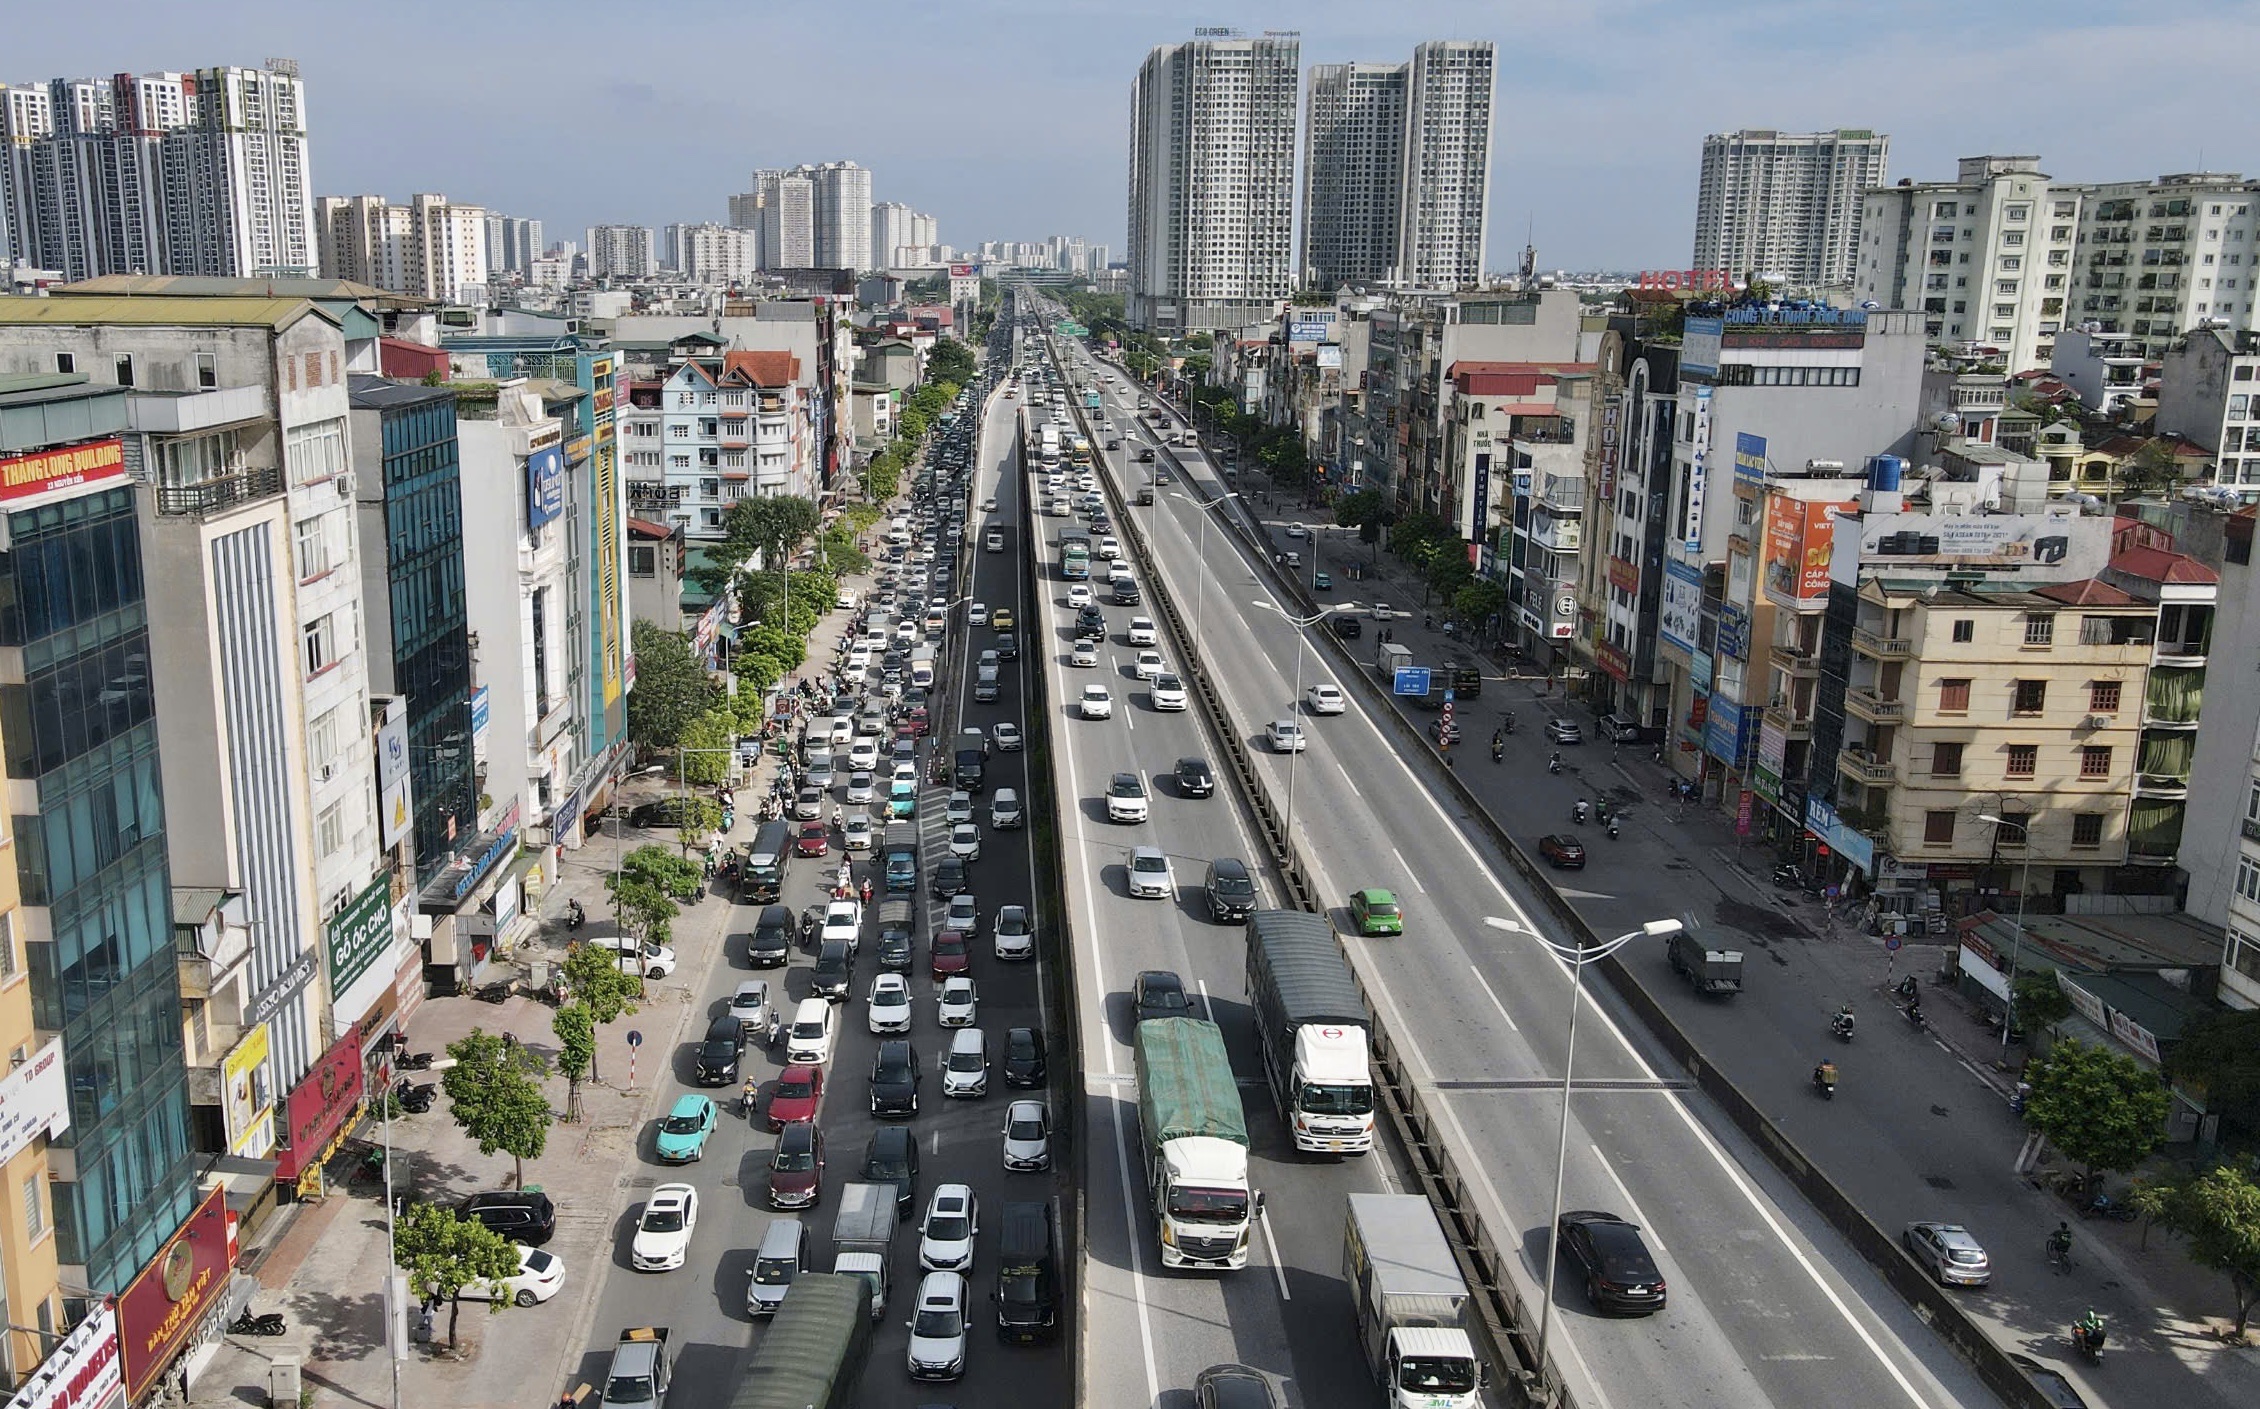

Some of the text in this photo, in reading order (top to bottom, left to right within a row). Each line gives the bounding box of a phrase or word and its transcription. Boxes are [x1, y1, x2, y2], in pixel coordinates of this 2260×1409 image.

[1208, 27, 1230, 37] GREEN
[1640, 269, 1738, 292] HOTEL
[42, 454, 74, 478] LONG
[73, 444, 122, 471] BUILDING
[1600, 408, 1618, 499] HOTEL
[1809, 800, 1829, 827] RÈM
[336, 899, 387, 967] GỖ ÓC CHÓ
[35, 1052, 55, 1076] GROUP
